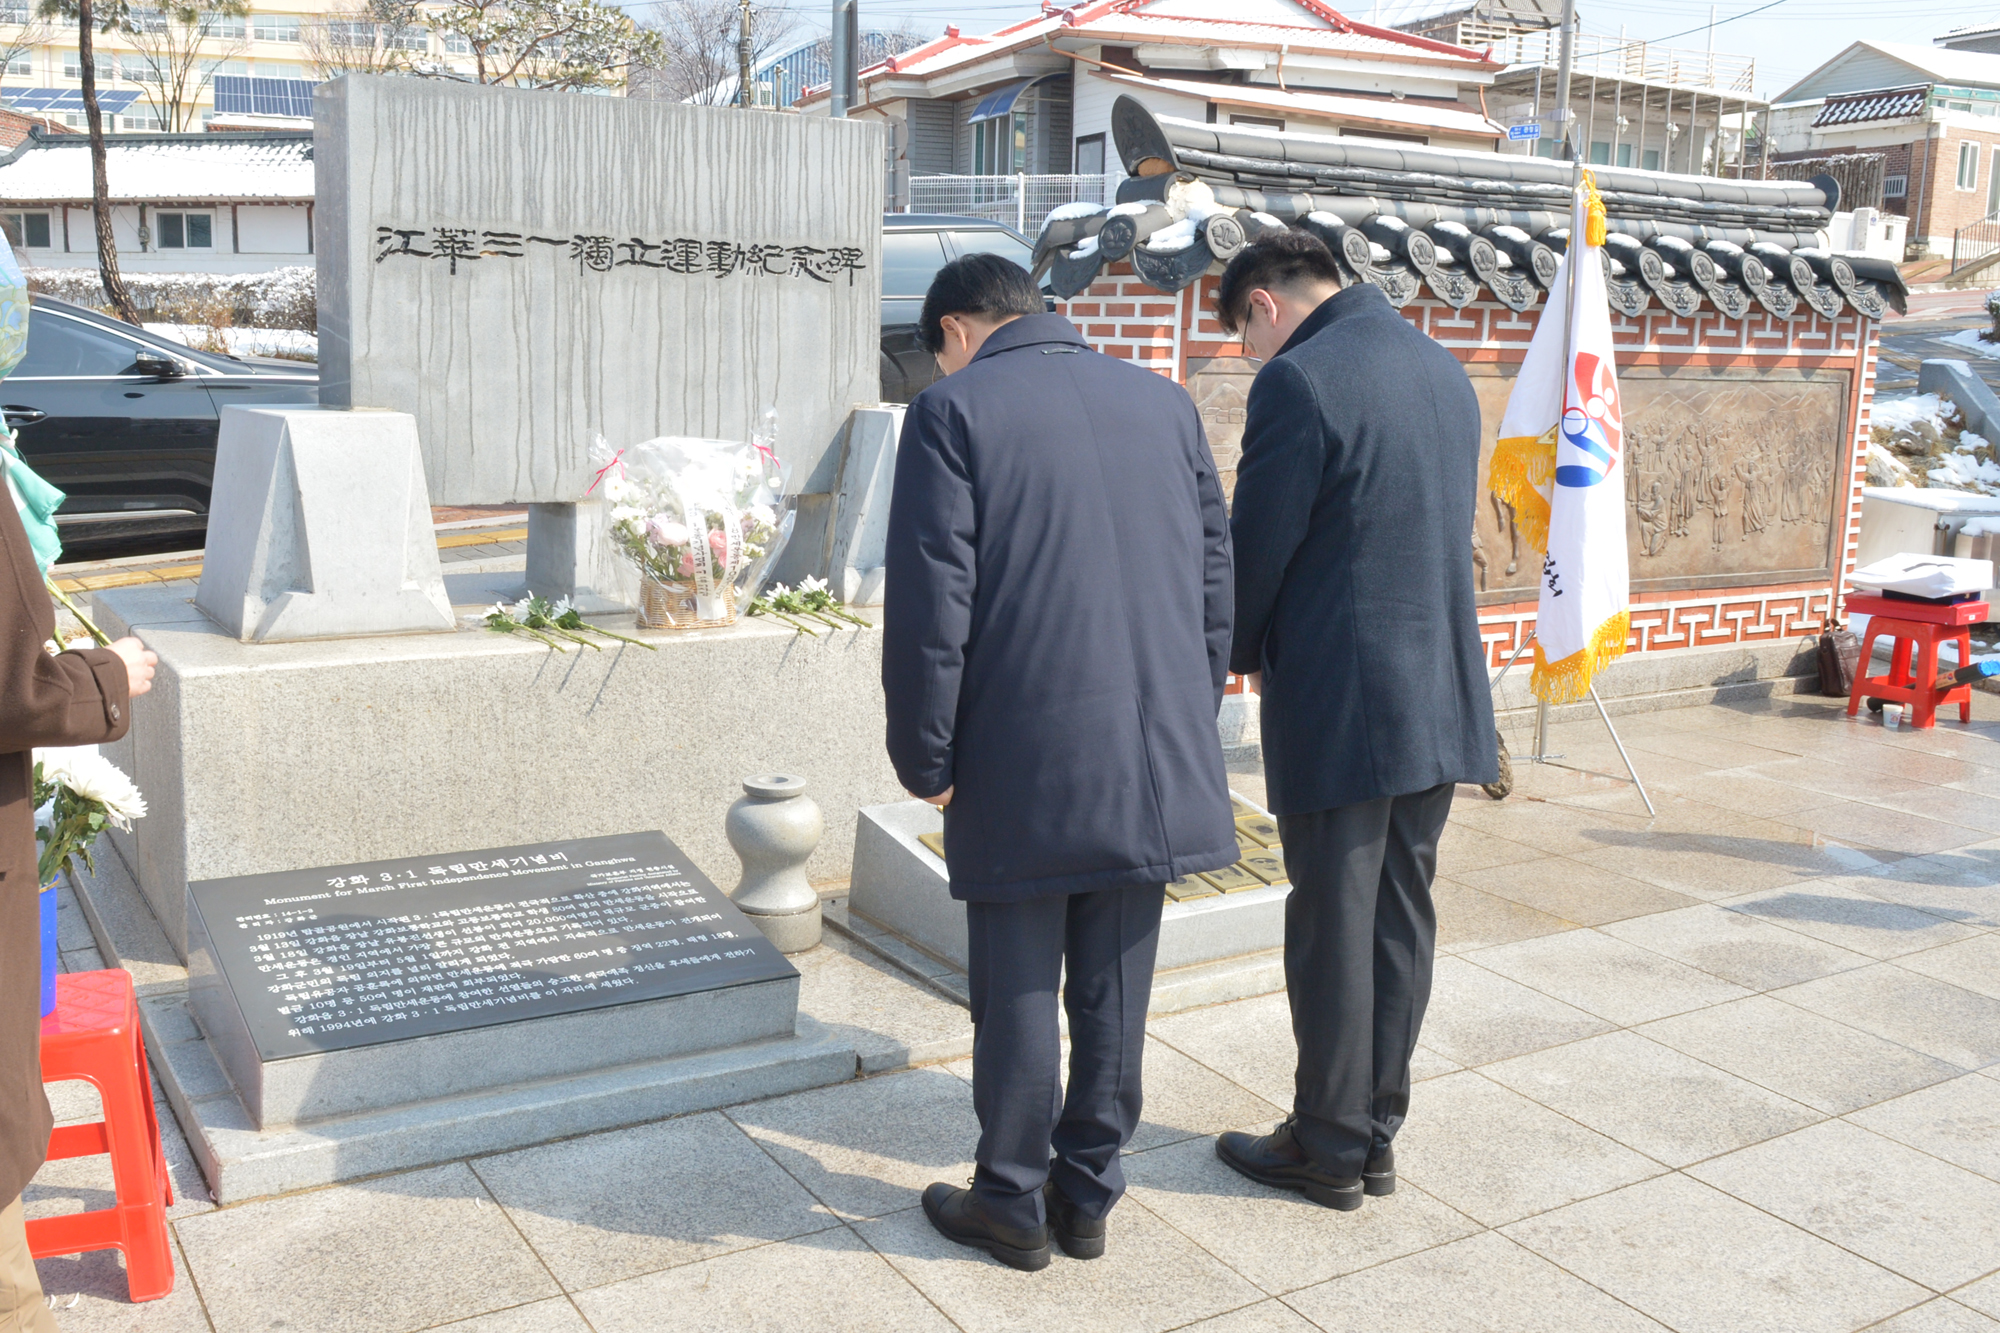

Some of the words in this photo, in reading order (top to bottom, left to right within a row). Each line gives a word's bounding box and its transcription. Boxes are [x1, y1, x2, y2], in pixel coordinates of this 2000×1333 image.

[263, 892, 332, 905] Monument
[355, 884, 396, 895] March
[397, 881, 428, 890] First
[430, 872, 509, 886] Independence
[510, 864, 569, 876] Movement
[584, 857, 636, 867] Ganghwa
[326, 874, 370, 889] 강화
[428, 852, 568, 875] 독립만세기념비
[249, 943, 271, 953] 3월
[274, 939, 301, 950] 13일
[304, 934, 342, 945] 강화읍
[344, 930, 369, 940] 장날
[372, 919, 454, 936] 강화보통학교와
[457, 911, 525, 925] 고등보통학교
[525, 907, 550, 916] 학생
[551, 903, 577, 912] 80여
[578, 900, 601, 909] 명의
[602, 894, 655, 906] 만세운동을
[658, 888, 699, 899] 시작으로
[253, 952, 276, 963] 3월
[312, 943, 351, 954] 강화읍
[354, 939, 380, 949] 장날
[461, 923, 497, 935] 선봉이
[499, 920, 524, 929] 되어
[602, 906, 636, 915] 대규모
[639, 900, 672, 911] 군중이
[673, 896, 707, 906] 참여한
[257, 929, 298, 942] 1919년
[376, 915, 412, 926] 시작된
[517, 895, 572, 908] 전국적으로
[573, 892, 596, 900] 확산
[597, 889, 619, 898] 중에
[621, 881, 691, 895] 강화지역에서는
[257, 957, 322, 972] 만세운동은
[326, 953, 352, 963] 경인
[355, 946, 404, 959] 지역에서
[407, 942, 431, 952] 가장
[435, 940, 448, 949] 큰
[451, 934, 487, 946] 규모의
[488, 926, 558, 941] 만세운동으로
[559, 919, 604, 931] 기록되어
[606, 915, 633, 925] 있다.
[267, 977, 332, 993] 강화군민의
[336, 973, 362, 983] 독립
[366, 967, 403, 979] 의지를
[406, 963, 432, 973] 널리
[435, 957, 472, 969] 알리게
[474, 951, 515, 963] 되었다.
[276, 973, 290, 981] 그
[294, 970, 308, 978] 후
[312, 966, 335, 976] 3월
[340, 958, 391, 972] 19일부터
[396, 954, 417, 964] 5월
[422, 948, 465, 960] 1일까지
[468, 944, 493, 954] 강화
[497, 941, 511, 950] 전
[514, 935, 560, 947] 지역에서
[564, 927, 620, 940] 지속적으로
[622, 919, 677, 932] 만세운동이
[680, 913, 723, 924] 전개되어
[284, 986, 350, 1001] 독립유공자
[353, 978, 404, 992] 공훈록에
[407, 972, 445, 984] 의하면
[446, 963, 508, 978] 만세운동에
[509, 959, 533, 969] 적극
[535, 954, 572, 965] 가담한
[600, 947, 614, 956] 명
[616, 946, 628, 954] 중
[630, 942, 654, 952] 징역
[276, 1004, 304, 1015] 벌금
[309, 999, 337, 1010] 10명
[341, 996, 355, 1006] 등
[359, 991, 388, 1003] 50여
[391, 987, 417, 998] 명이
[420, 981, 459, 993] 재판에
[462, 972, 526, 987] 회부되었다.
[288, 1025, 315, 1037] 위해
[319, 1016, 378, 1032] 1994년에
[380, 1011, 408, 1023] 강화
[444, 991, 542, 1012] 독립만세기념비를
[545, 988, 558, 997] 이
[560, 982, 597, 994] 자리에
[294, 1011, 334, 1024] 강화읍
[369, 993, 454, 1012] 독립만세운동에
[457, 987, 494, 999] 참여한
[498, 979, 545, 993] 선열들의
[547, 973, 583, 986] 숭고한
[632, 962, 666, 973] 정신을
[669, 953, 722, 967] 후세들에게
[723, 948, 756, 959] 전하기
